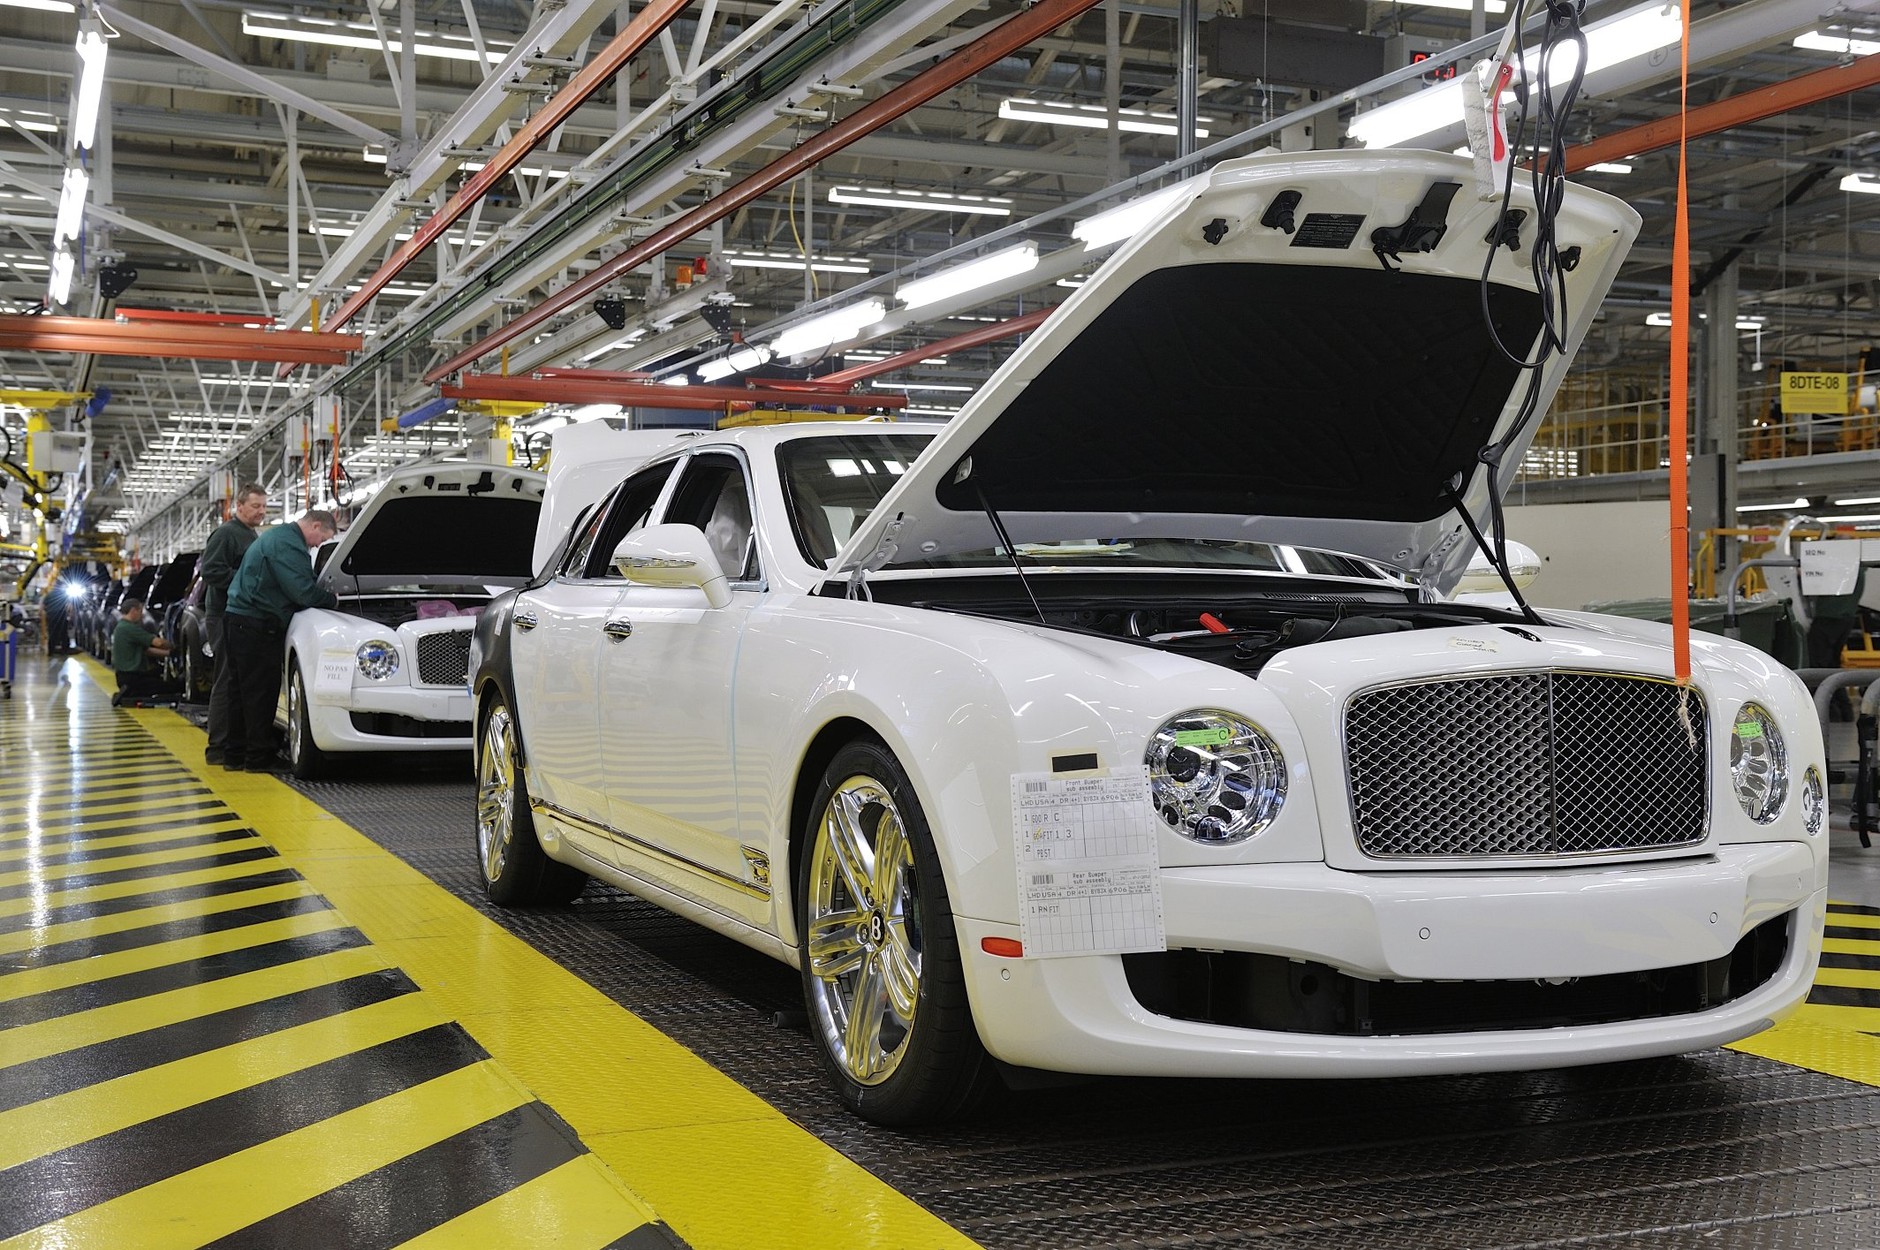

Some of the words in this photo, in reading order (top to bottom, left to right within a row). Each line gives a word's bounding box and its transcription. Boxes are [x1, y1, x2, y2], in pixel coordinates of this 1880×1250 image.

[1789, 376, 1840, 389] 8DTE-08
[1218, 729, 1227, 741] C
[1065, 829, 1072, 838] 3
[1025, 845, 1031, 853] 2
